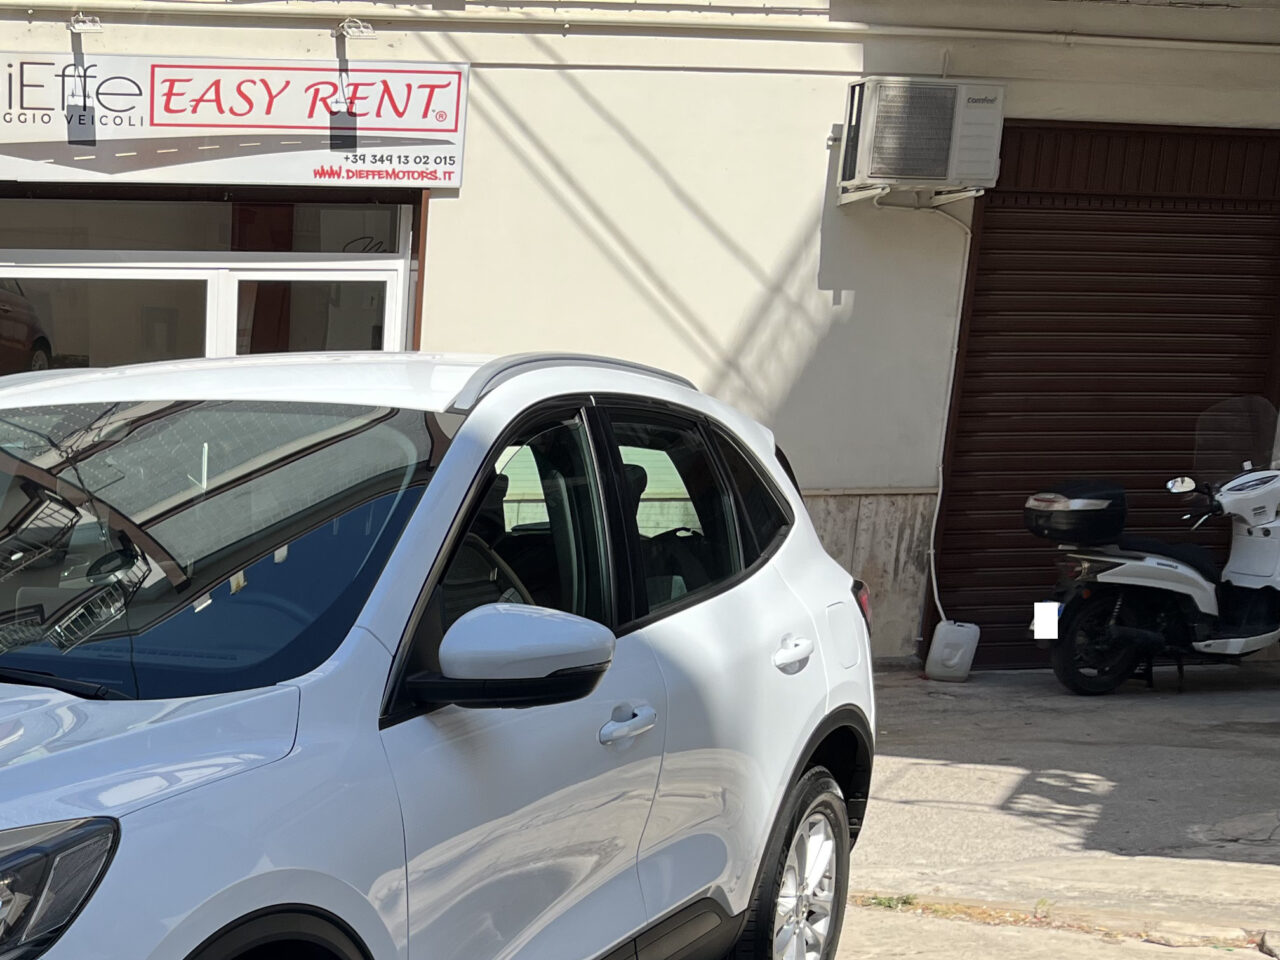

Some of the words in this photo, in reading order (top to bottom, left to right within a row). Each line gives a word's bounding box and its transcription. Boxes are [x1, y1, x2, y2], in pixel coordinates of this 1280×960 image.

[161, 78, 291, 117] EASY
[65, 114, 144, 127] VEICOLI
[344, 154, 366, 164] +39
[370, 154, 393, 165] 349
[397, 155, 410, 165] 13
[413, 155, 430, 165] 02
[434, 155, 456, 166] 015
